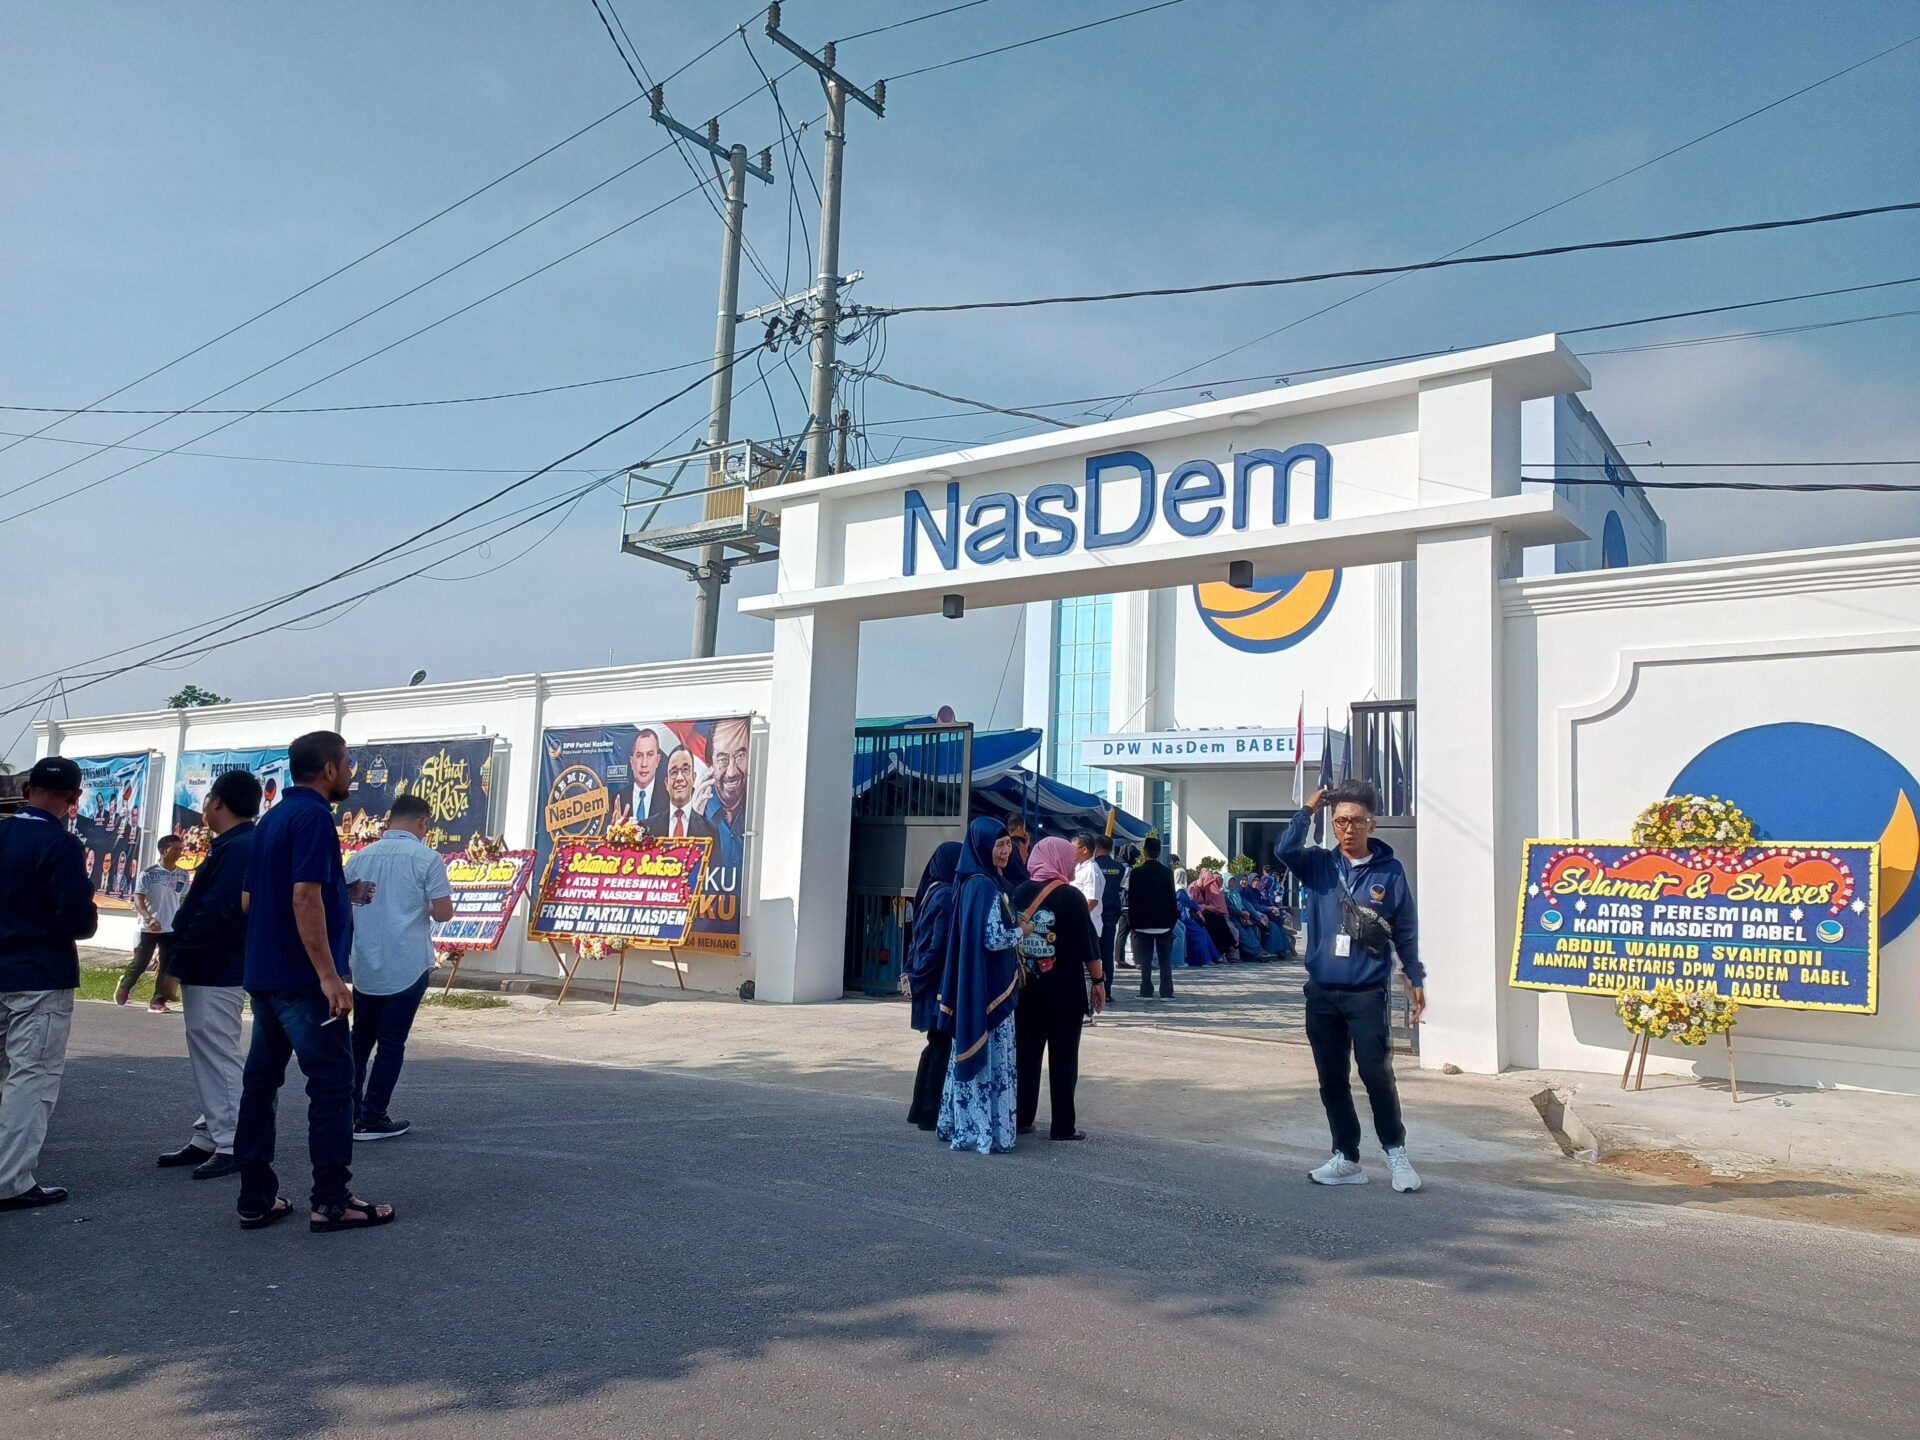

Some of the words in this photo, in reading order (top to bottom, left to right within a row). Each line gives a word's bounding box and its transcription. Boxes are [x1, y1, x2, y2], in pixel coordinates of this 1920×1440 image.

[902, 442, 1332, 576] NasDem
[1103, 742, 1141, 755] DPW
[1152, 740, 1225, 754] NasDem
[1236, 738, 1295, 753] BABEL
[554, 772, 593, 800] SEMUA
[549, 797, 604, 824] NasDem
[568, 852, 622, 875] Selamat
[622, 858, 635, 875] &
[636, 853, 683, 877] Sukses
[572, 876, 600, 887] ATAS
[602, 878, 669, 890] PERESMIAN
[1553, 868, 1680, 901] Selamat
[1686, 874, 1711, 899] &
[1727, 872, 1834, 905] Sukses
[555, 888, 597, 899] KANTOR
[600, 890, 644, 901] NASDEM
[646, 891, 681, 903] BABEL
[540, 904, 584, 920] FRAKSI
[585, 906, 631, 922] PARTAI
[632, 909, 688, 926] NASDEM
[1598, 903, 1643, 918] ATAS
[1653, 904, 1779, 923] PERESMIAN
[1573, 918, 1644, 935] KANTOR
[1650, 921, 1733, 938] NASDEM
[1742, 924, 1807, 942] BABEL
[698, 937, 736, 950] MENANG
[1023, 939, 1045, 947] GREAT
[1556, 937, 1616, 955] ABDUL
[1625, 941, 1699, 959] WAHAB
[1712, 946, 1822, 966] SYAHRONI
[1533, 953, 1587, 970] MANTAN
[1592, 957, 1676, 976] SEKRETARIS
[1683, 961, 1715, 977] DPW
[1724, 964, 1789, 982] NASDEM
[1800, 968, 1849, 986] BABEL
[1588, 973, 1646, 990] PENDIRI
[1655, 977, 1718, 995] NASDEM
[1731, 982, 1780, 999] BABEL
